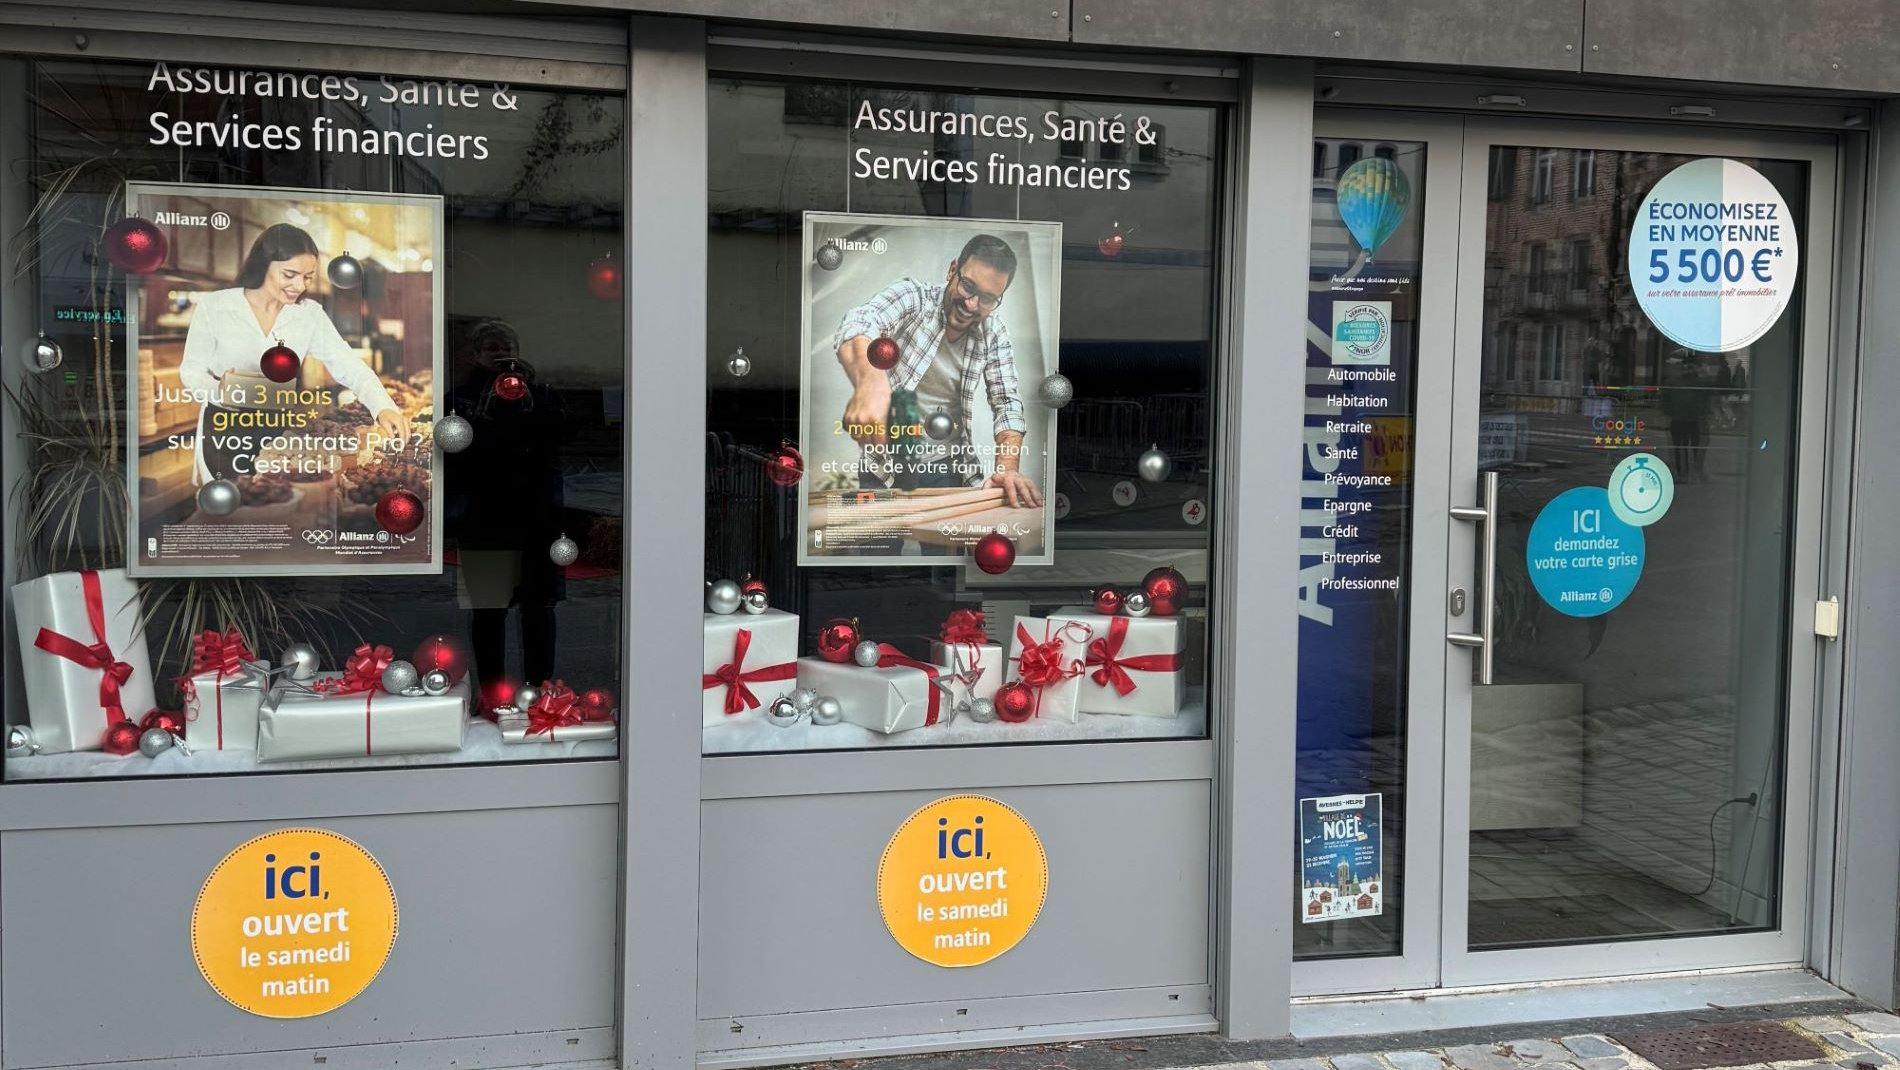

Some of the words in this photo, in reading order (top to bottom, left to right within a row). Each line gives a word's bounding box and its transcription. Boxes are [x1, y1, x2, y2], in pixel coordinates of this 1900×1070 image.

[148, 61, 368, 107] Assurances,
[492, 83, 518, 111] &
[854, 100, 1034, 143] Assurances,
[1043, 110, 1126, 144] Santé
[1135, 116, 1157, 146] &
[149, 112, 301, 151] Services
[312, 117, 489, 160] financiers
[854, 148, 978, 184] Services
[988, 152, 1131, 191] financiers
[1649, 198, 1778, 220] ÉCONOMISEZ
[154, 211, 208, 226] Allianz
[1649, 225, 1675, 242] EN
[1681, 225, 1780, 242] MOYENNE
[827, 237, 869, 251] llianz
[1647, 289, 1660, 297] sur
[1661, 288, 1681, 297] votre
[1682, 289, 1719, 297] assurance
[1736, 287, 1777, 297] immobilier
[1327, 368, 1397, 382] Automobile
[253, 385, 267, 404] 3
[276, 386, 333, 405] mois
[1327, 394, 1388, 408] Habitation
[834, 421, 843, 435] 2
[849, 421, 886, 436] mois
[1326, 420, 1372, 434] Retraite
[1592, 415, 1645, 434] Google
[167, 435, 205, 450] sur
[211, 435, 253, 450] vos
[260, 433, 358, 451] contrats
[366, 432, 405, 452] Pro
[864, 442, 901, 458] pour
[905, 441, 946, 455] votre
[950, 441, 1029, 459] protection
[1325, 446, 1358, 460] Santé
[298, 454, 323, 474] ici
[821, 461, 838, 473] et
[842, 459, 879, 473] celle
[885, 459, 903, 474] de
[907, 461, 949, 474] votre
[952, 459, 1006, 474] famille
[1324, 473, 1391, 489] Prévoyance
[1323, 499, 1372, 515] Epargne
[1573, 509, 1600, 533] ICI
[339, 531, 375, 541] Allianz
[1322, 524, 1358, 538] Crédit
[1554, 536, 1619, 551] demandez
[1322, 552, 1381, 567] Entreprise
[1534, 556, 1567, 570] votre
[1572, 554, 1604, 568] carte
[1607, 552, 1638, 569] grise
[1321, 576, 1399, 590] Professionnel
[1560, 591, 1597, 602] Allianz
[938, 815, 991, 860] ici,
[265, 851, 329, 900] ici,
[918, 866, 1007, 894] ouvert
[917, 902, 934, 922] le
[938, 898, 1008, 921] samedi
[242, 907, 349, 937] ouvert
[934, 928, 991, 949] matin
[240, 946, 261, 967] le
[267, 941, 350, 966] samedi
[262, 974, 330, 997] matin
